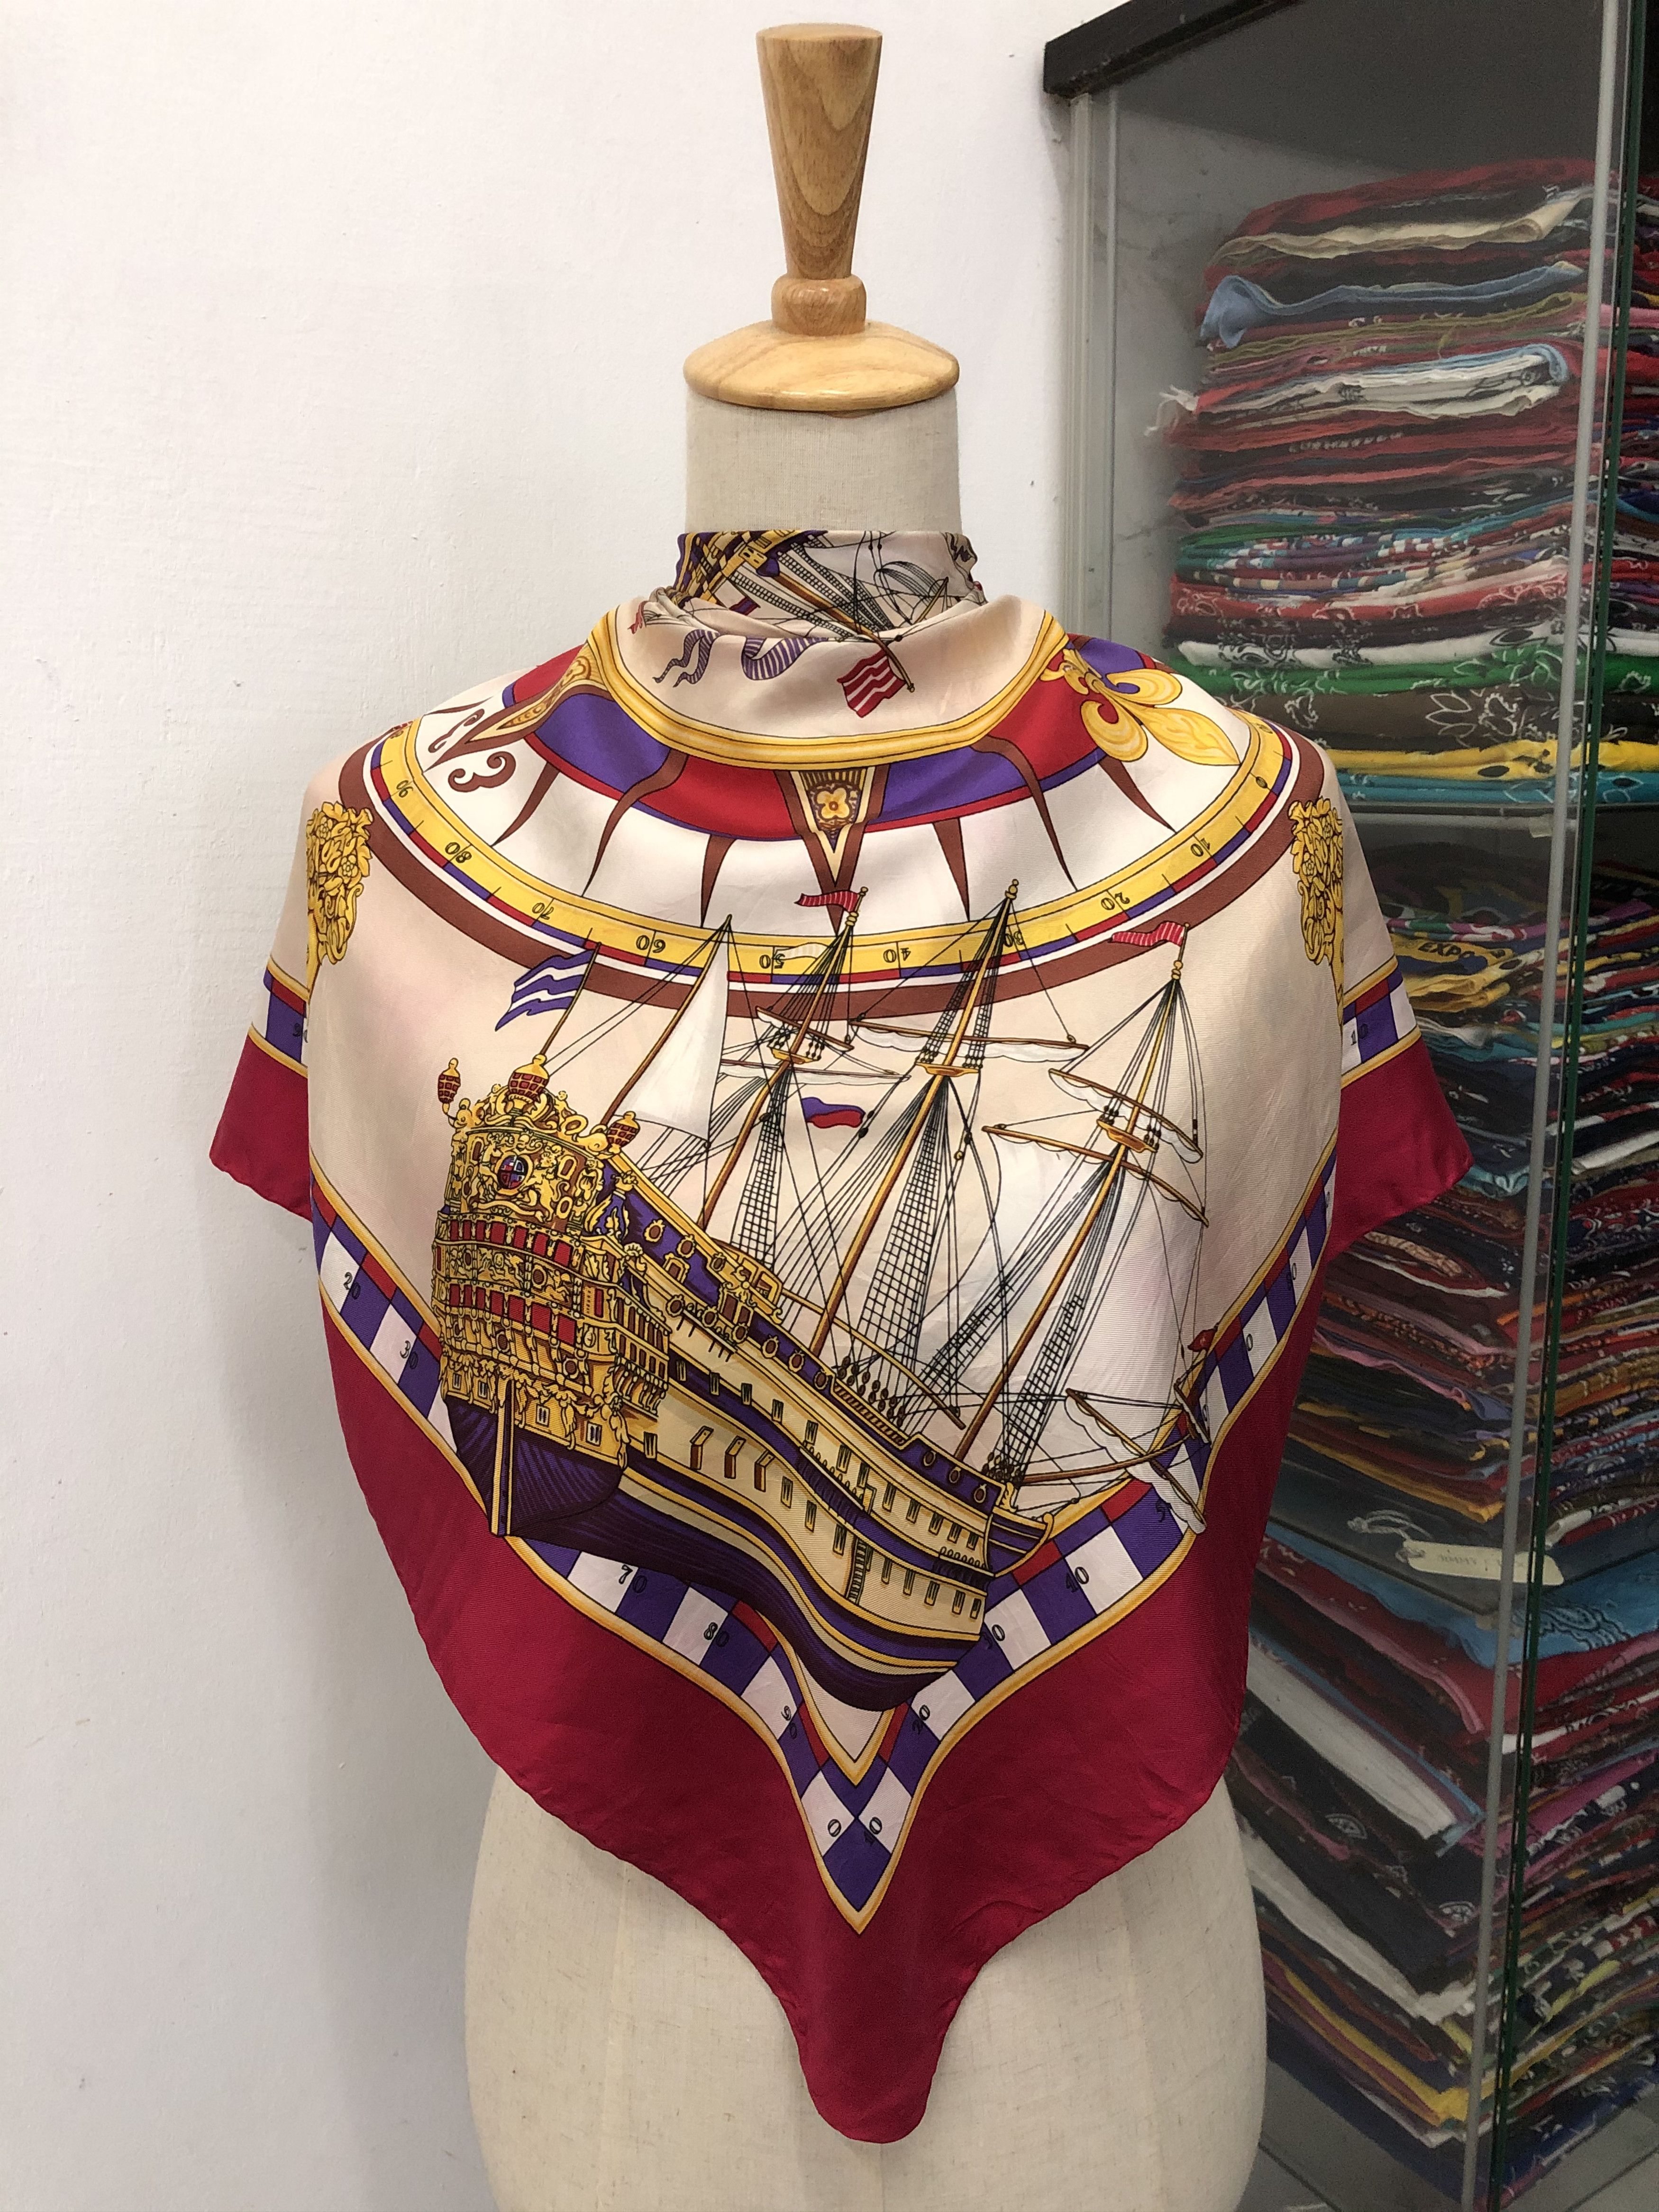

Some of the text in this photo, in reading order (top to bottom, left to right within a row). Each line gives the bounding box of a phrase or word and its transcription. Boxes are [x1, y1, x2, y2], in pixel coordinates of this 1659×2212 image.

[445, 842, 472, 864] 80
[1191, 837, 1211, 857] 10
[531, 901, 554, 920] 70
[1101, 892, 1130, 911] 20
[759, 953, 785, 969] 50
[883, 947, 911, 963] 40
[1350, 1023, 1368, 1046] 10
[344, 1272, 361, 1300] 20
[400, 1340, 419, 1370] 30
[618, 1564, 647, 1593] 70
[1065, 1566, 1090, 1593] 40
[704, 1622, 730, 1648] 80
[781, 1705, 798, 1739] 90
[912, 1704, 930, 1736] 20
[863, 1816, 883, 1846] 10
